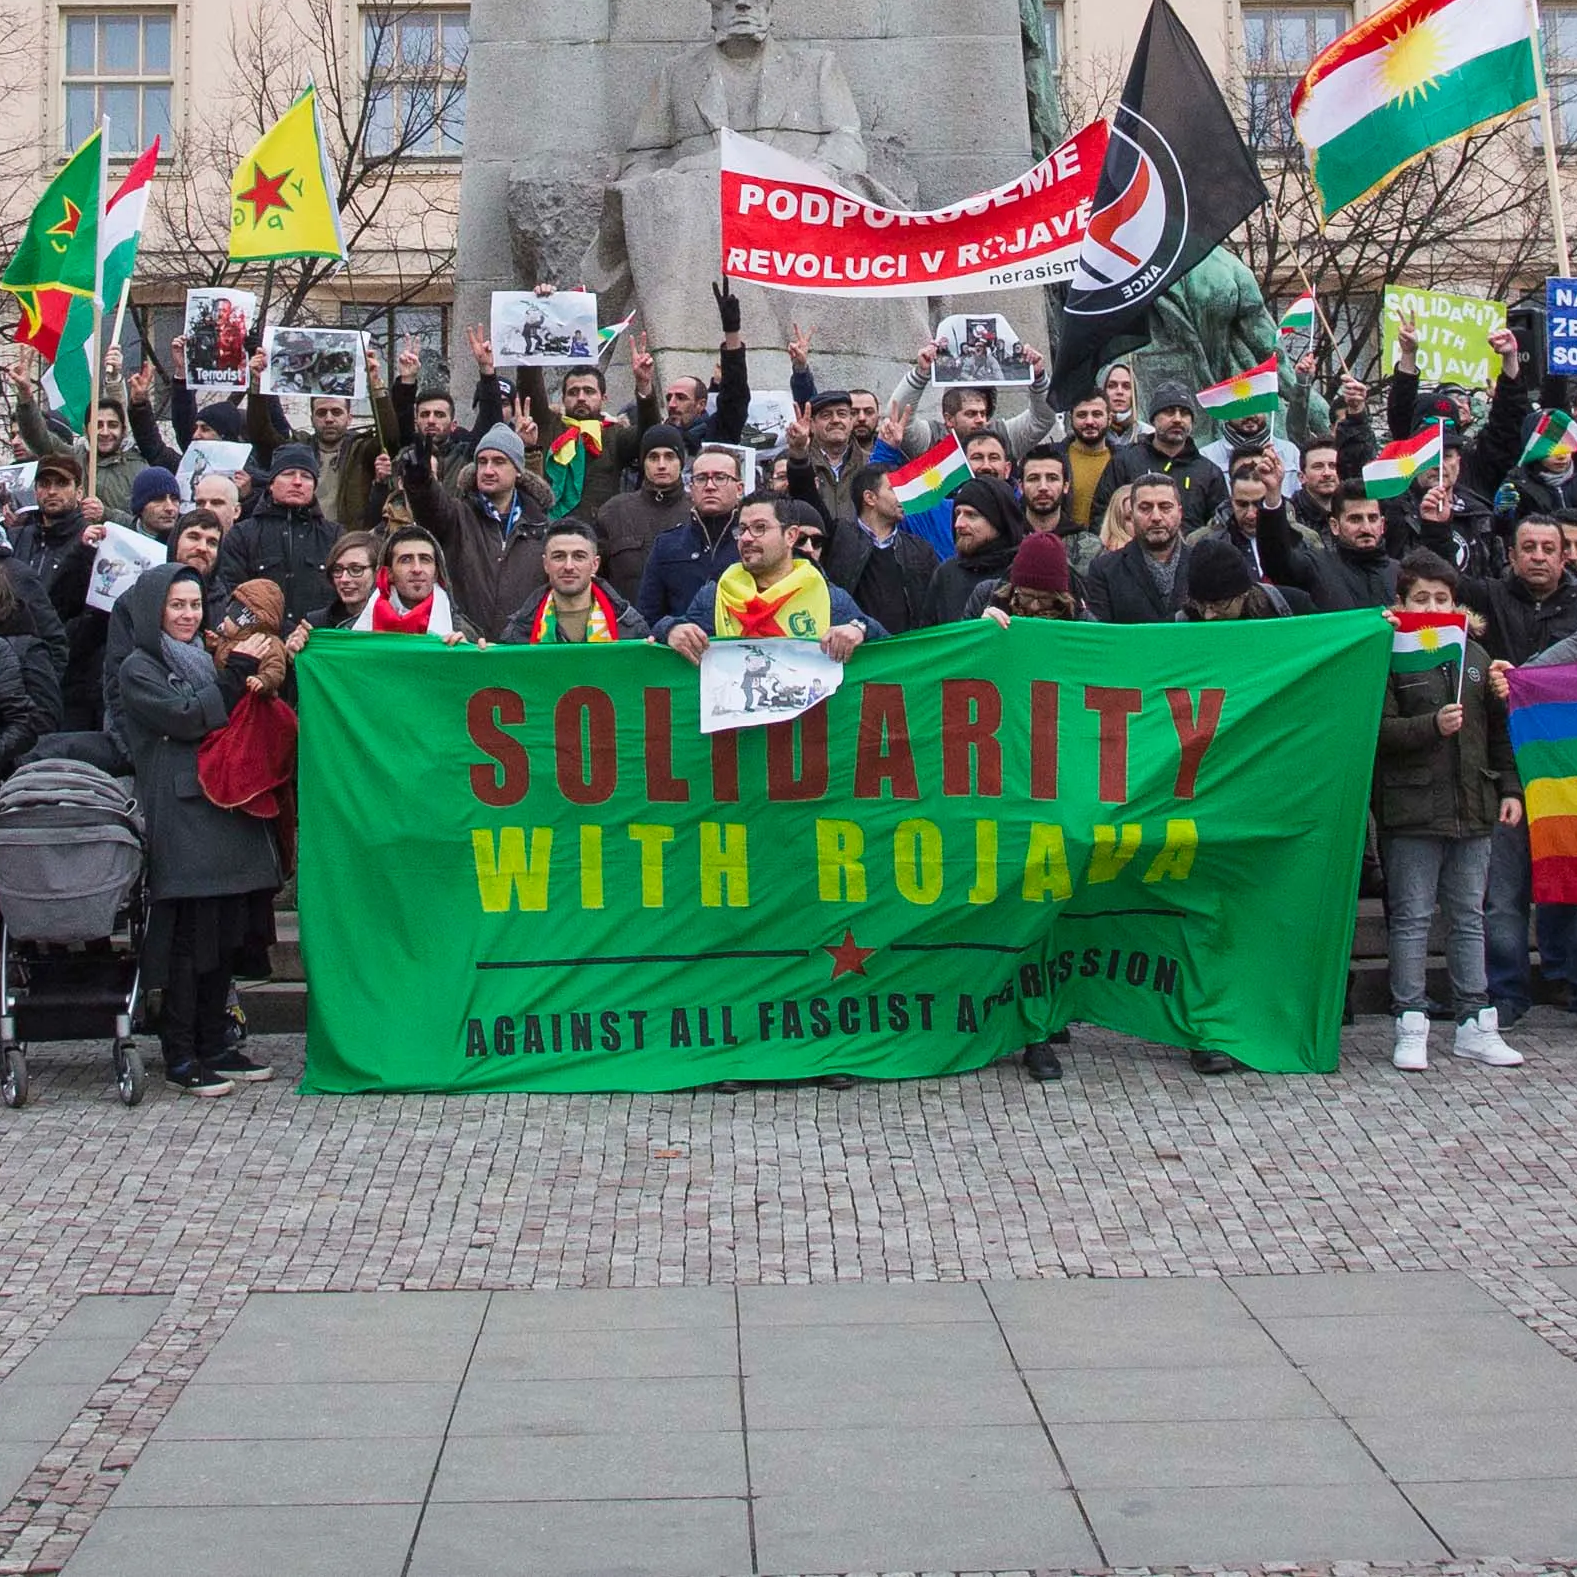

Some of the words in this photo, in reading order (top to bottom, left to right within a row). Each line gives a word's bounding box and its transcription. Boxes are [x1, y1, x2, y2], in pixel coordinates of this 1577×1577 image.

[727, 247, 907, 281] REVOLUCI
[921, 250, 946, 273] V
[958, 197, 1093, 268] ROJAVĚ
[466, 678, 1226, 808] SOLIDARITY
[471, 821, 749, 912] WITH
[816, 818, 1198, 905] ROJAVA
[465, 1009, 648, 1059] AGAINST
[669, 1005, 738, 1049] ALL
[757, 992, 935, 1043] FASCIST
